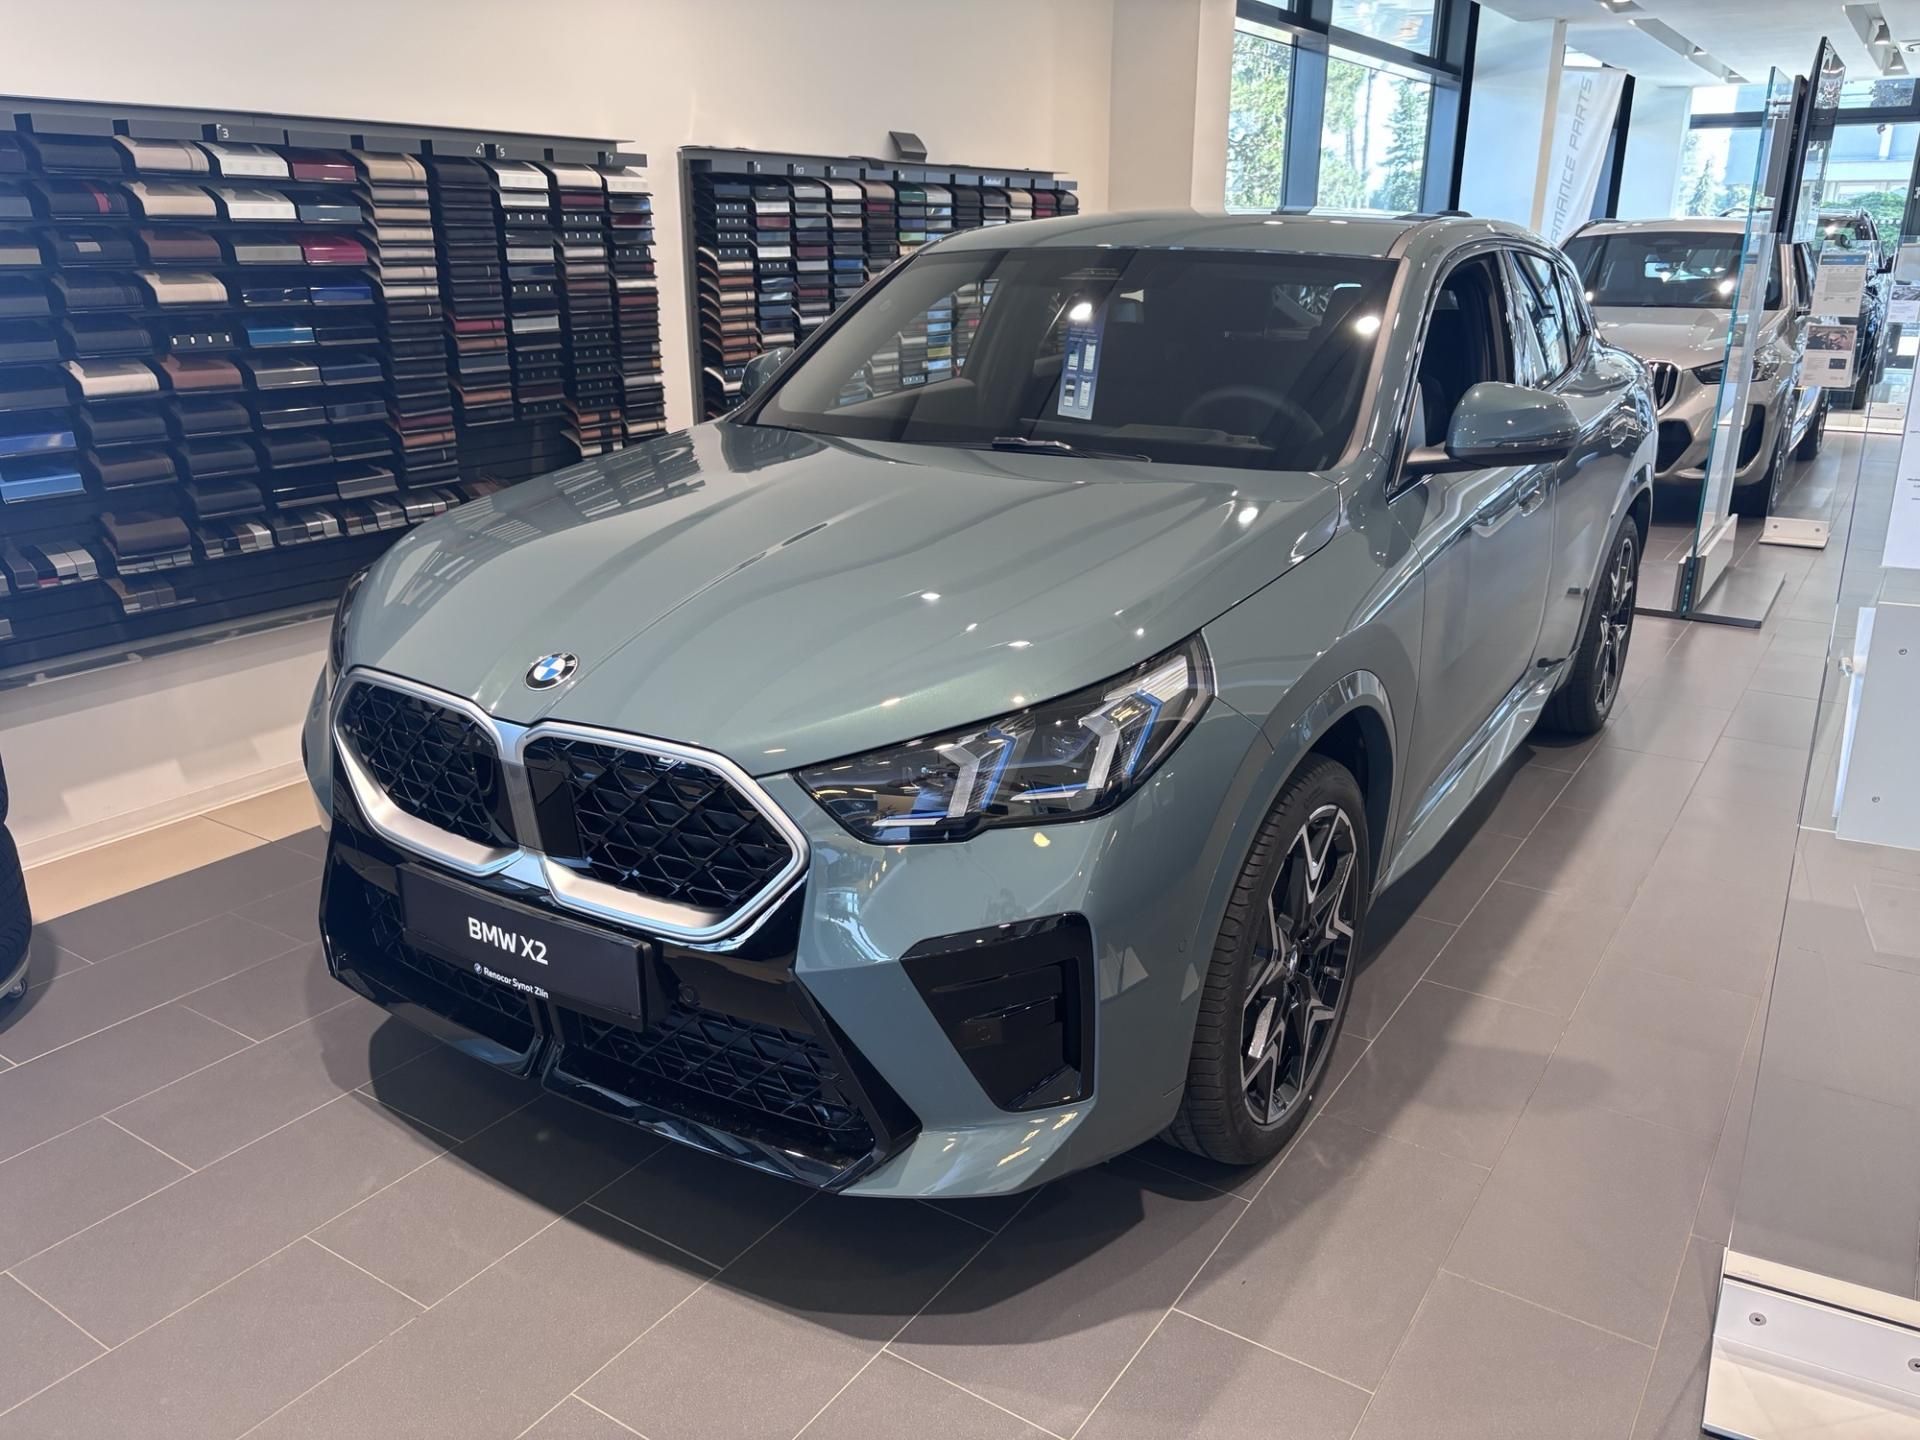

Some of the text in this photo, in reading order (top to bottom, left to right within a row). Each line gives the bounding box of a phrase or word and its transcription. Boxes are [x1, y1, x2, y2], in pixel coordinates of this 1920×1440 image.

[222, 128, 229, 138] 3
[1551, 75, 1593, 244] RMANCE PARTS
[468, 917, 549, 965] BMW X2
[483, 966, 512, 985] Renocar
[512, 978, 534, 994] Synot
